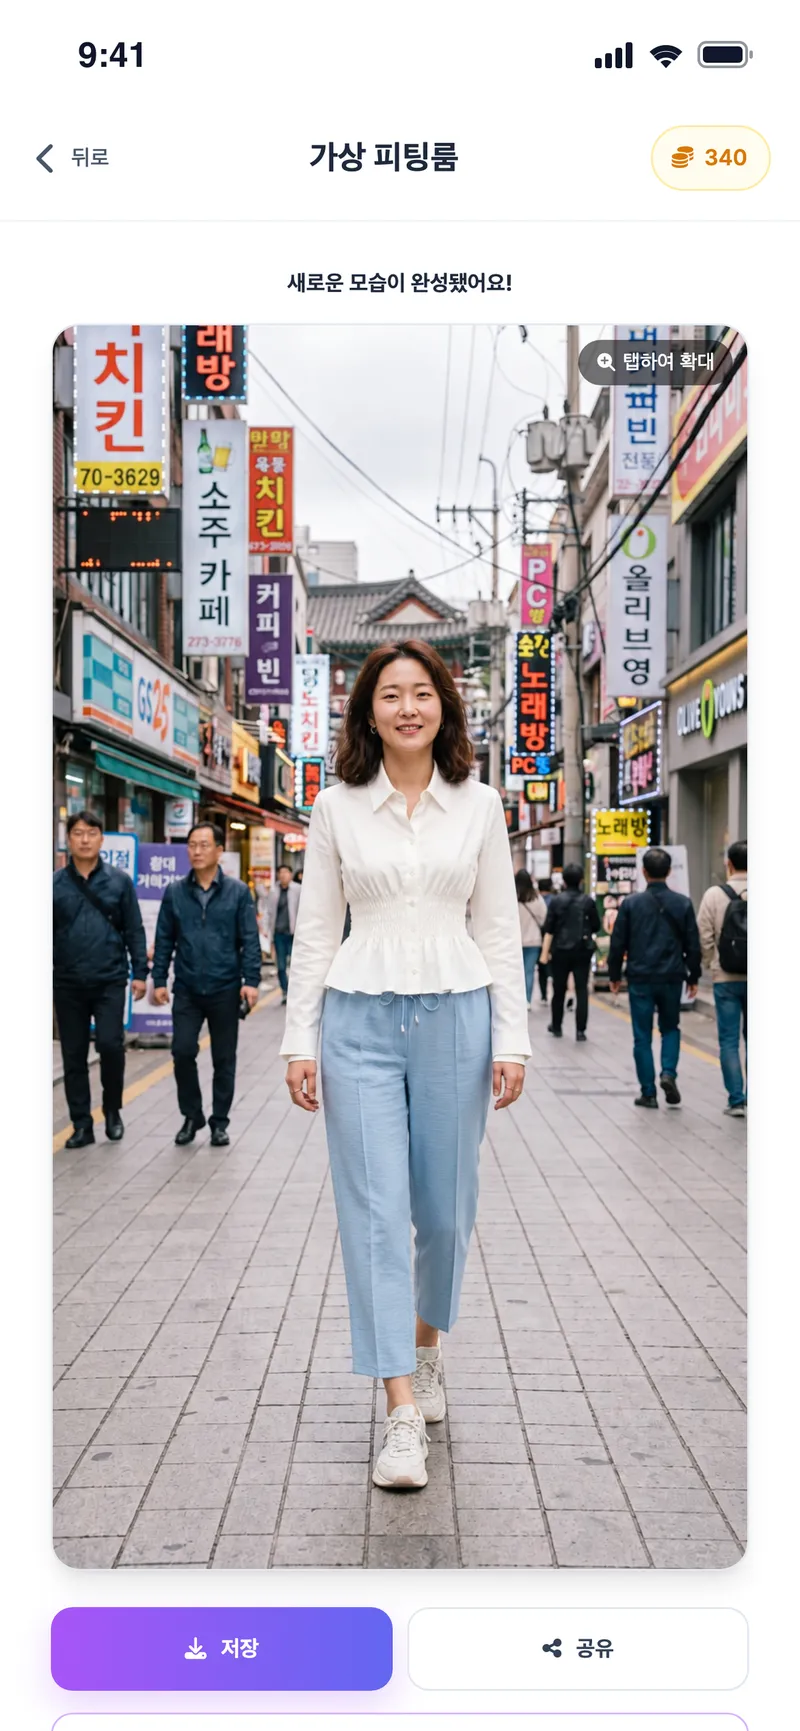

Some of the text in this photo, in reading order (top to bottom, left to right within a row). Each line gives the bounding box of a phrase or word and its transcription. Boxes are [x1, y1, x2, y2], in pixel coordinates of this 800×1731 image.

[93, 325, 144, 453] 치킨
[79, 467, 161, 487] 70-3629
[255, 475, 285, 539] 치킨
[198, 481, 232, 627] 소주 카페
[255, 582, 281, 639] 커피
[622, 564, 653, 686] 올리브영
[256, 657, 281, 686] 빈
[137, 677, 172, 743] GS25
[519, 662, 549, 752] 노래방
[597, 817, 648, 838] 노래방
